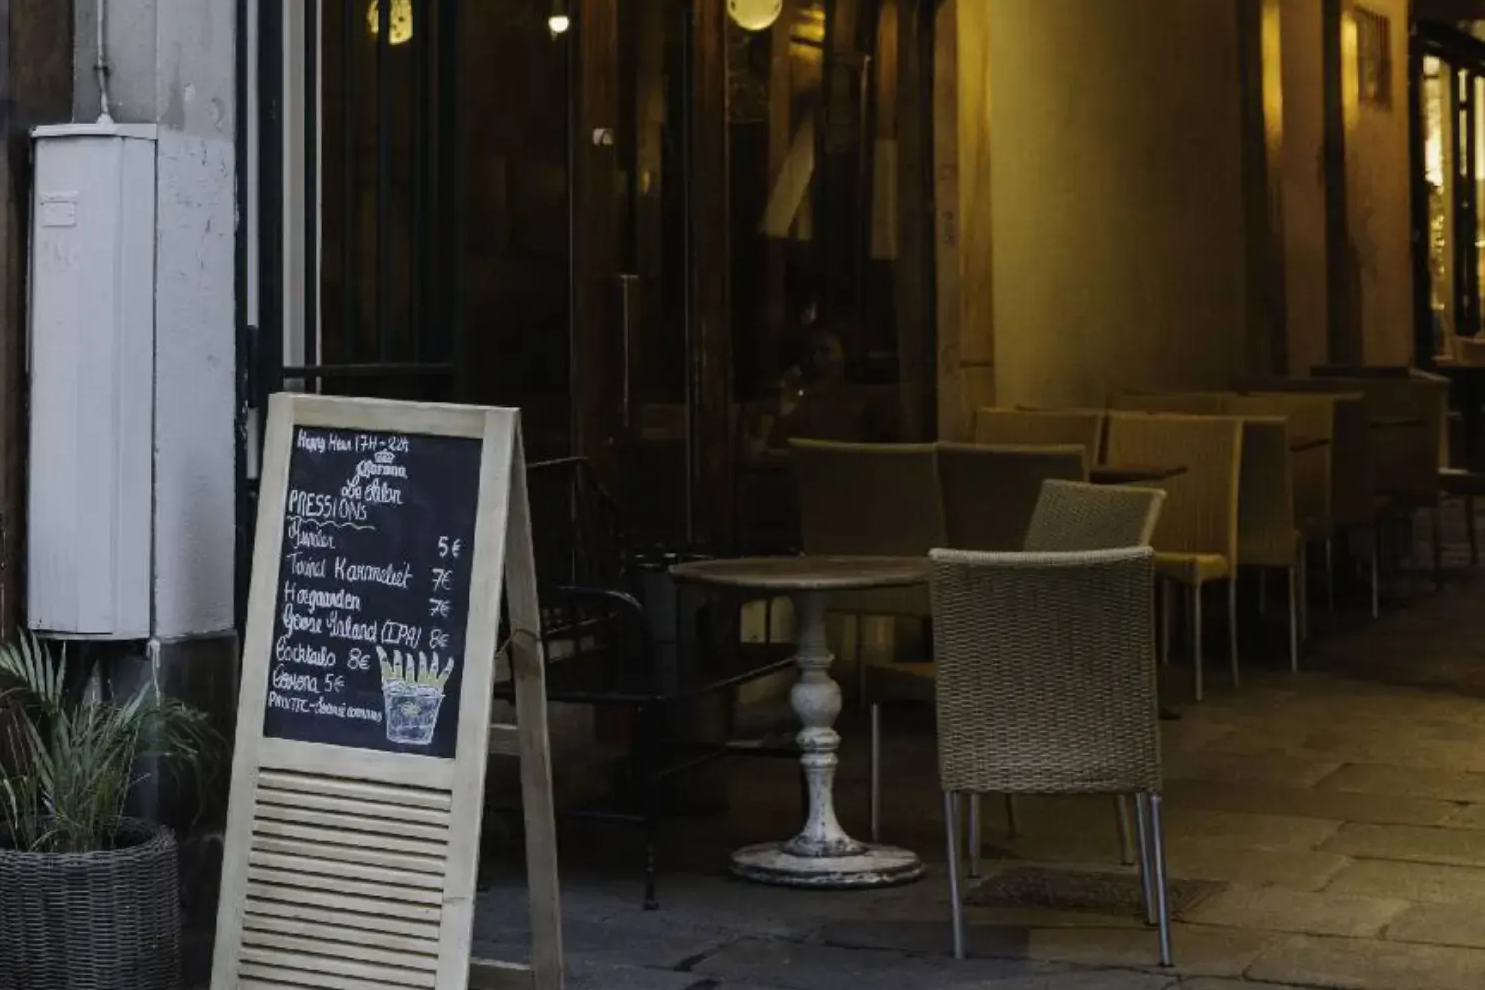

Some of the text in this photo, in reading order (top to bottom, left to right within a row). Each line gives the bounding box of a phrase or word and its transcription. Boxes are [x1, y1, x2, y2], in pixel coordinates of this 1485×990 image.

[355, 434, 378, 453] 17H
[288, 490, 368, 521] PRESSIONS
[346, 647, 371, 670] 8€
